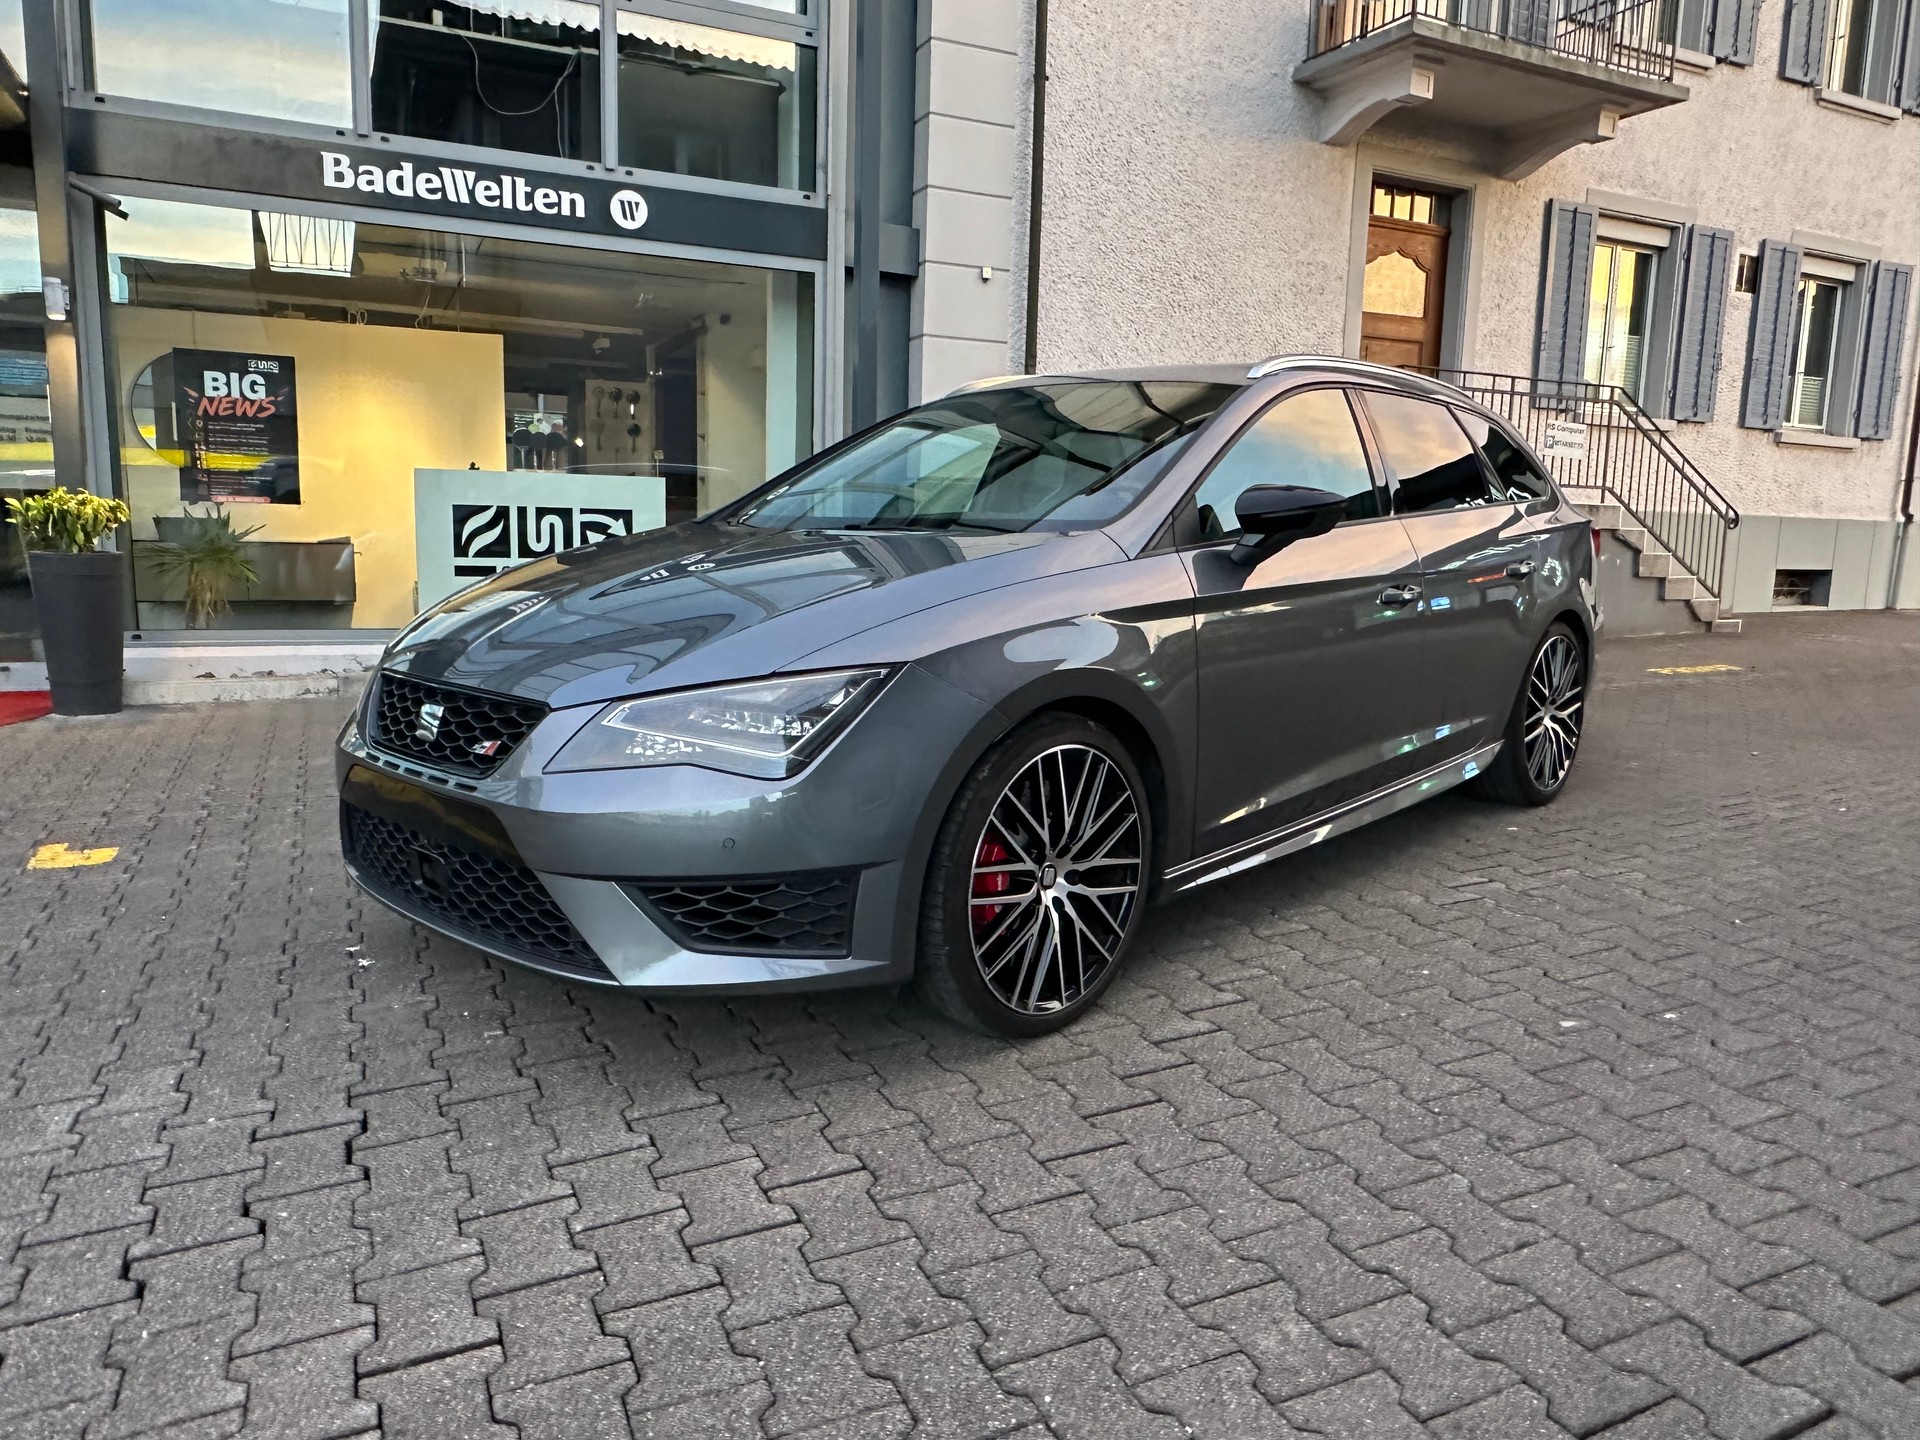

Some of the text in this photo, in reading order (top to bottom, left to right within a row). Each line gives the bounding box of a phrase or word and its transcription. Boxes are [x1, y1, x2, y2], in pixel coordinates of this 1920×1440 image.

[320, 151, 586, 219] BadeWelten
[203, 370, 267, 400] BIG
[197, 396, 277, 418] NEWS
